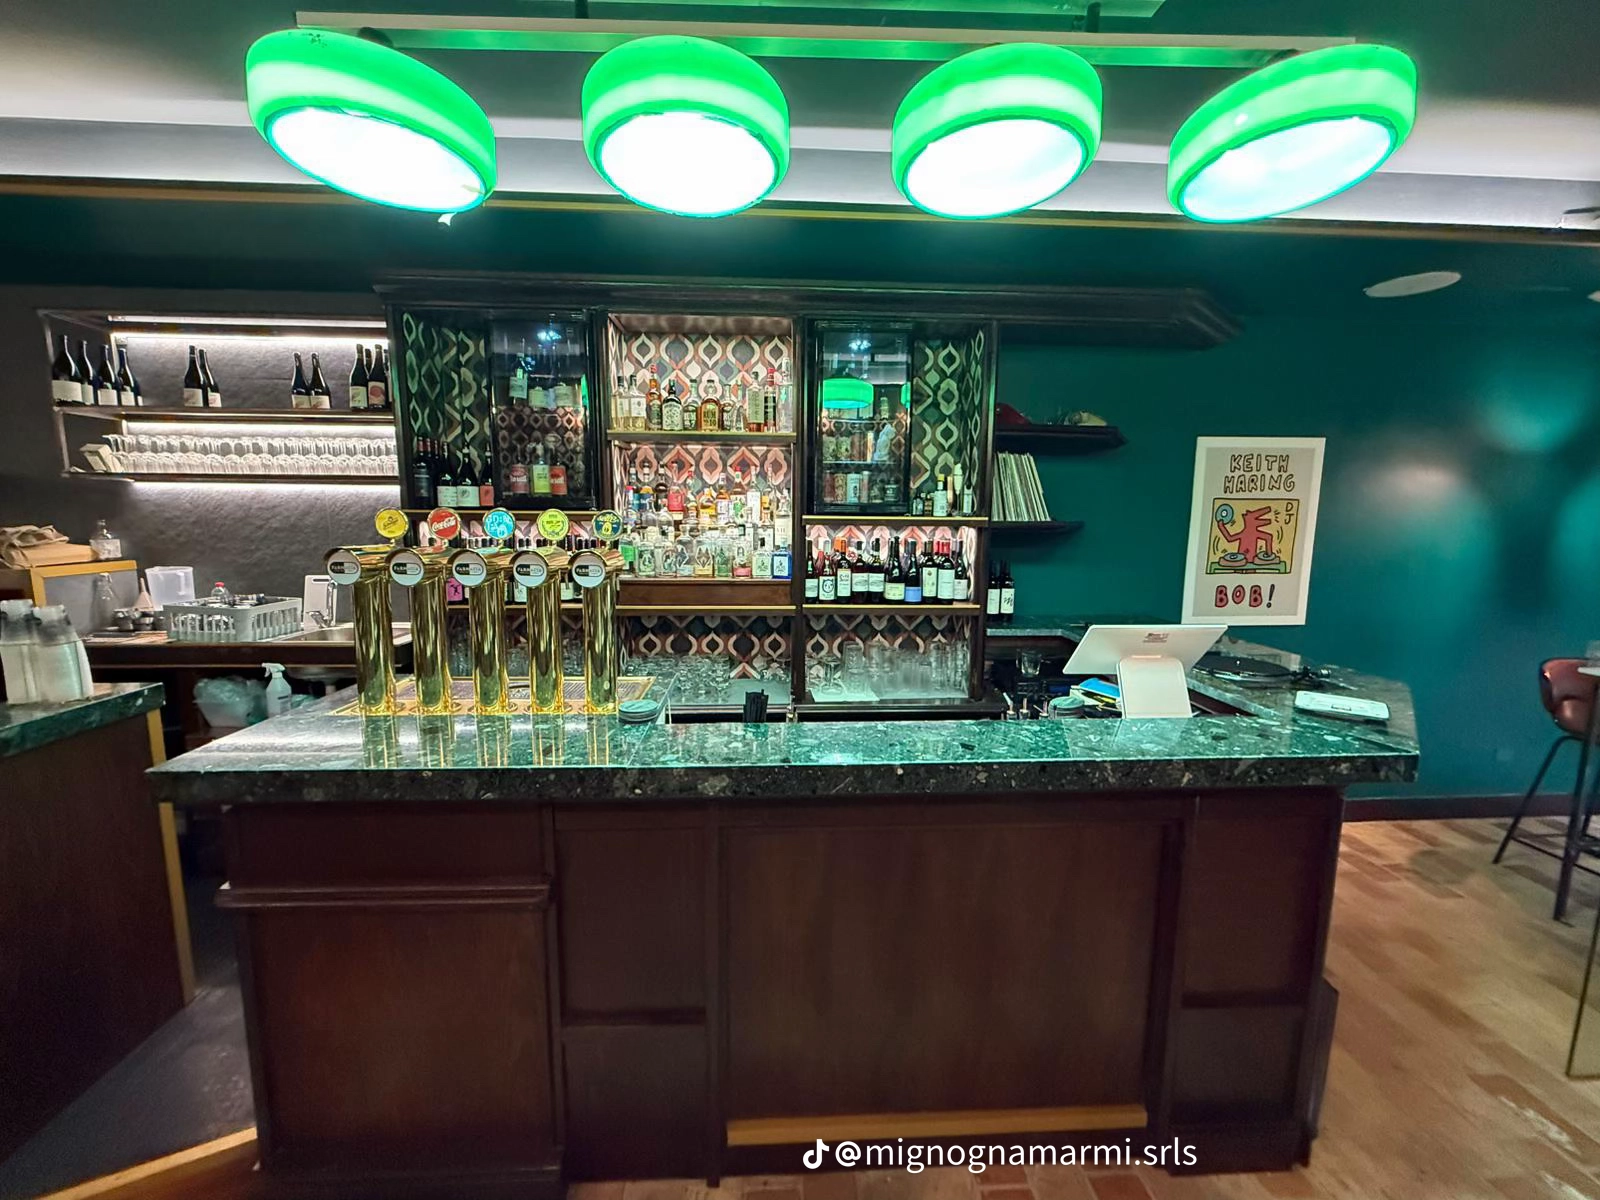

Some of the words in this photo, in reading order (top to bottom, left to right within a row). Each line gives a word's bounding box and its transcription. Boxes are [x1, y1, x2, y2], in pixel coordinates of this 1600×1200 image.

[1230, 454, 1290, 473] KEITH
[1223, 474, 1295, 494] HARING
[1214, 584, 1276, 608] BOB!
